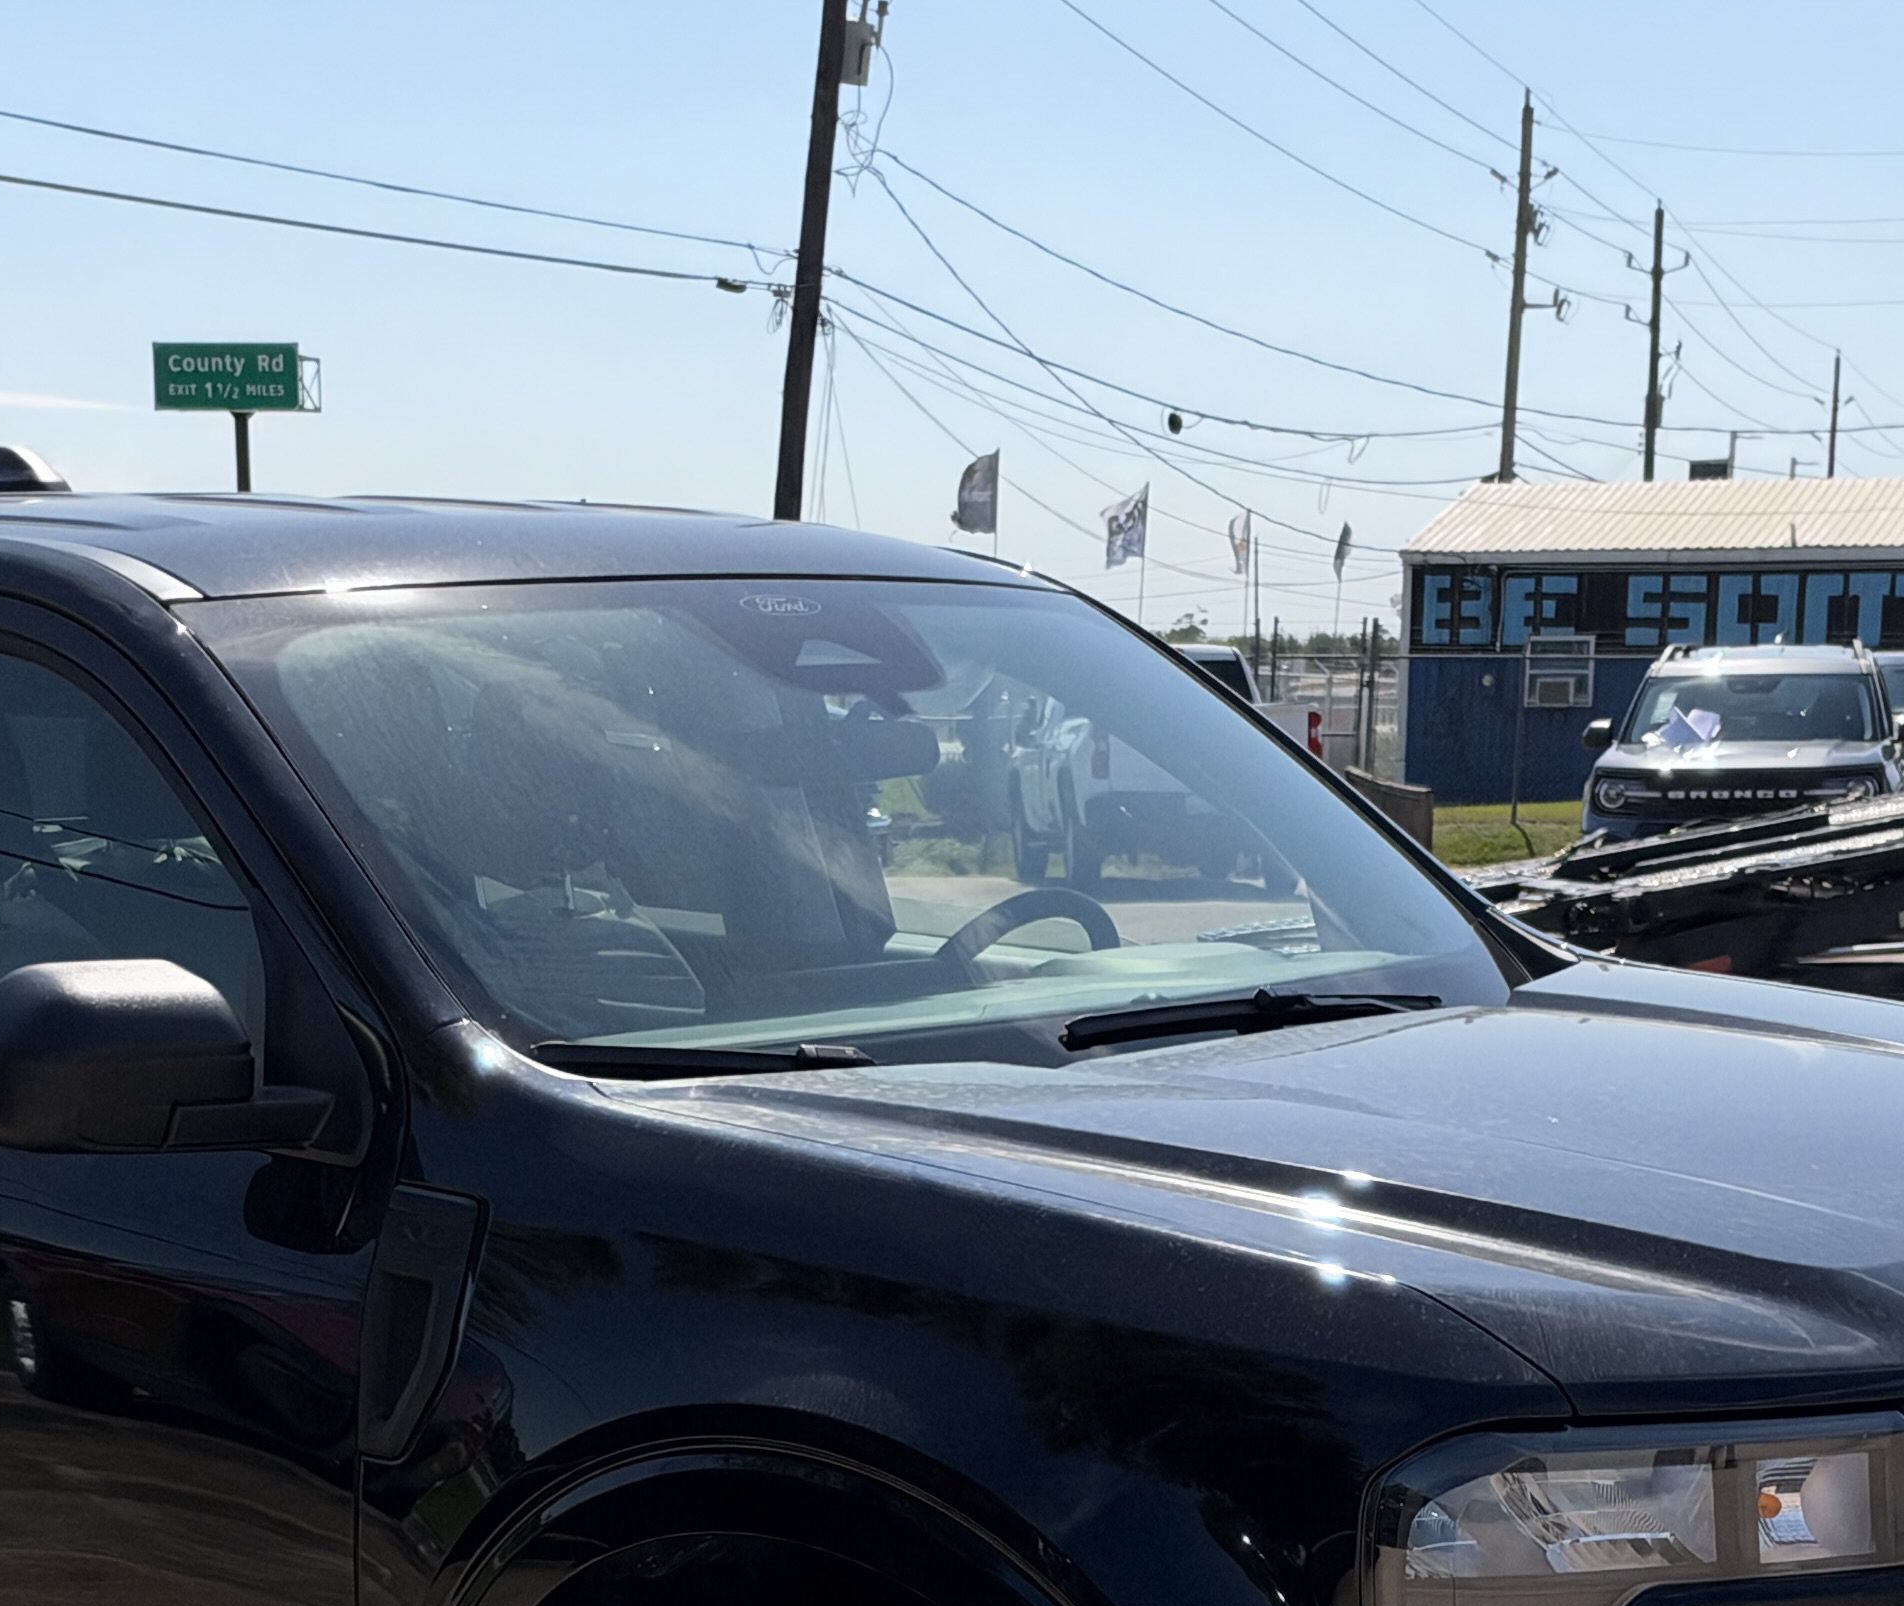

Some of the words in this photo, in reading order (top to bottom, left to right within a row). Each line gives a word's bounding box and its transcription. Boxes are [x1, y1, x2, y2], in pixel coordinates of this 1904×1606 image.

[168, 354, 245, 377] County
[257, 354, 284, 372] Rd
[169, 384, 197, 396] EXIT
[246, 384, 285, 396] MILES
[755, 597, 809, 612] Ford
[1422, 574, 1579, 646] BE
[1667, 789, 1798, 800] BRONCO
